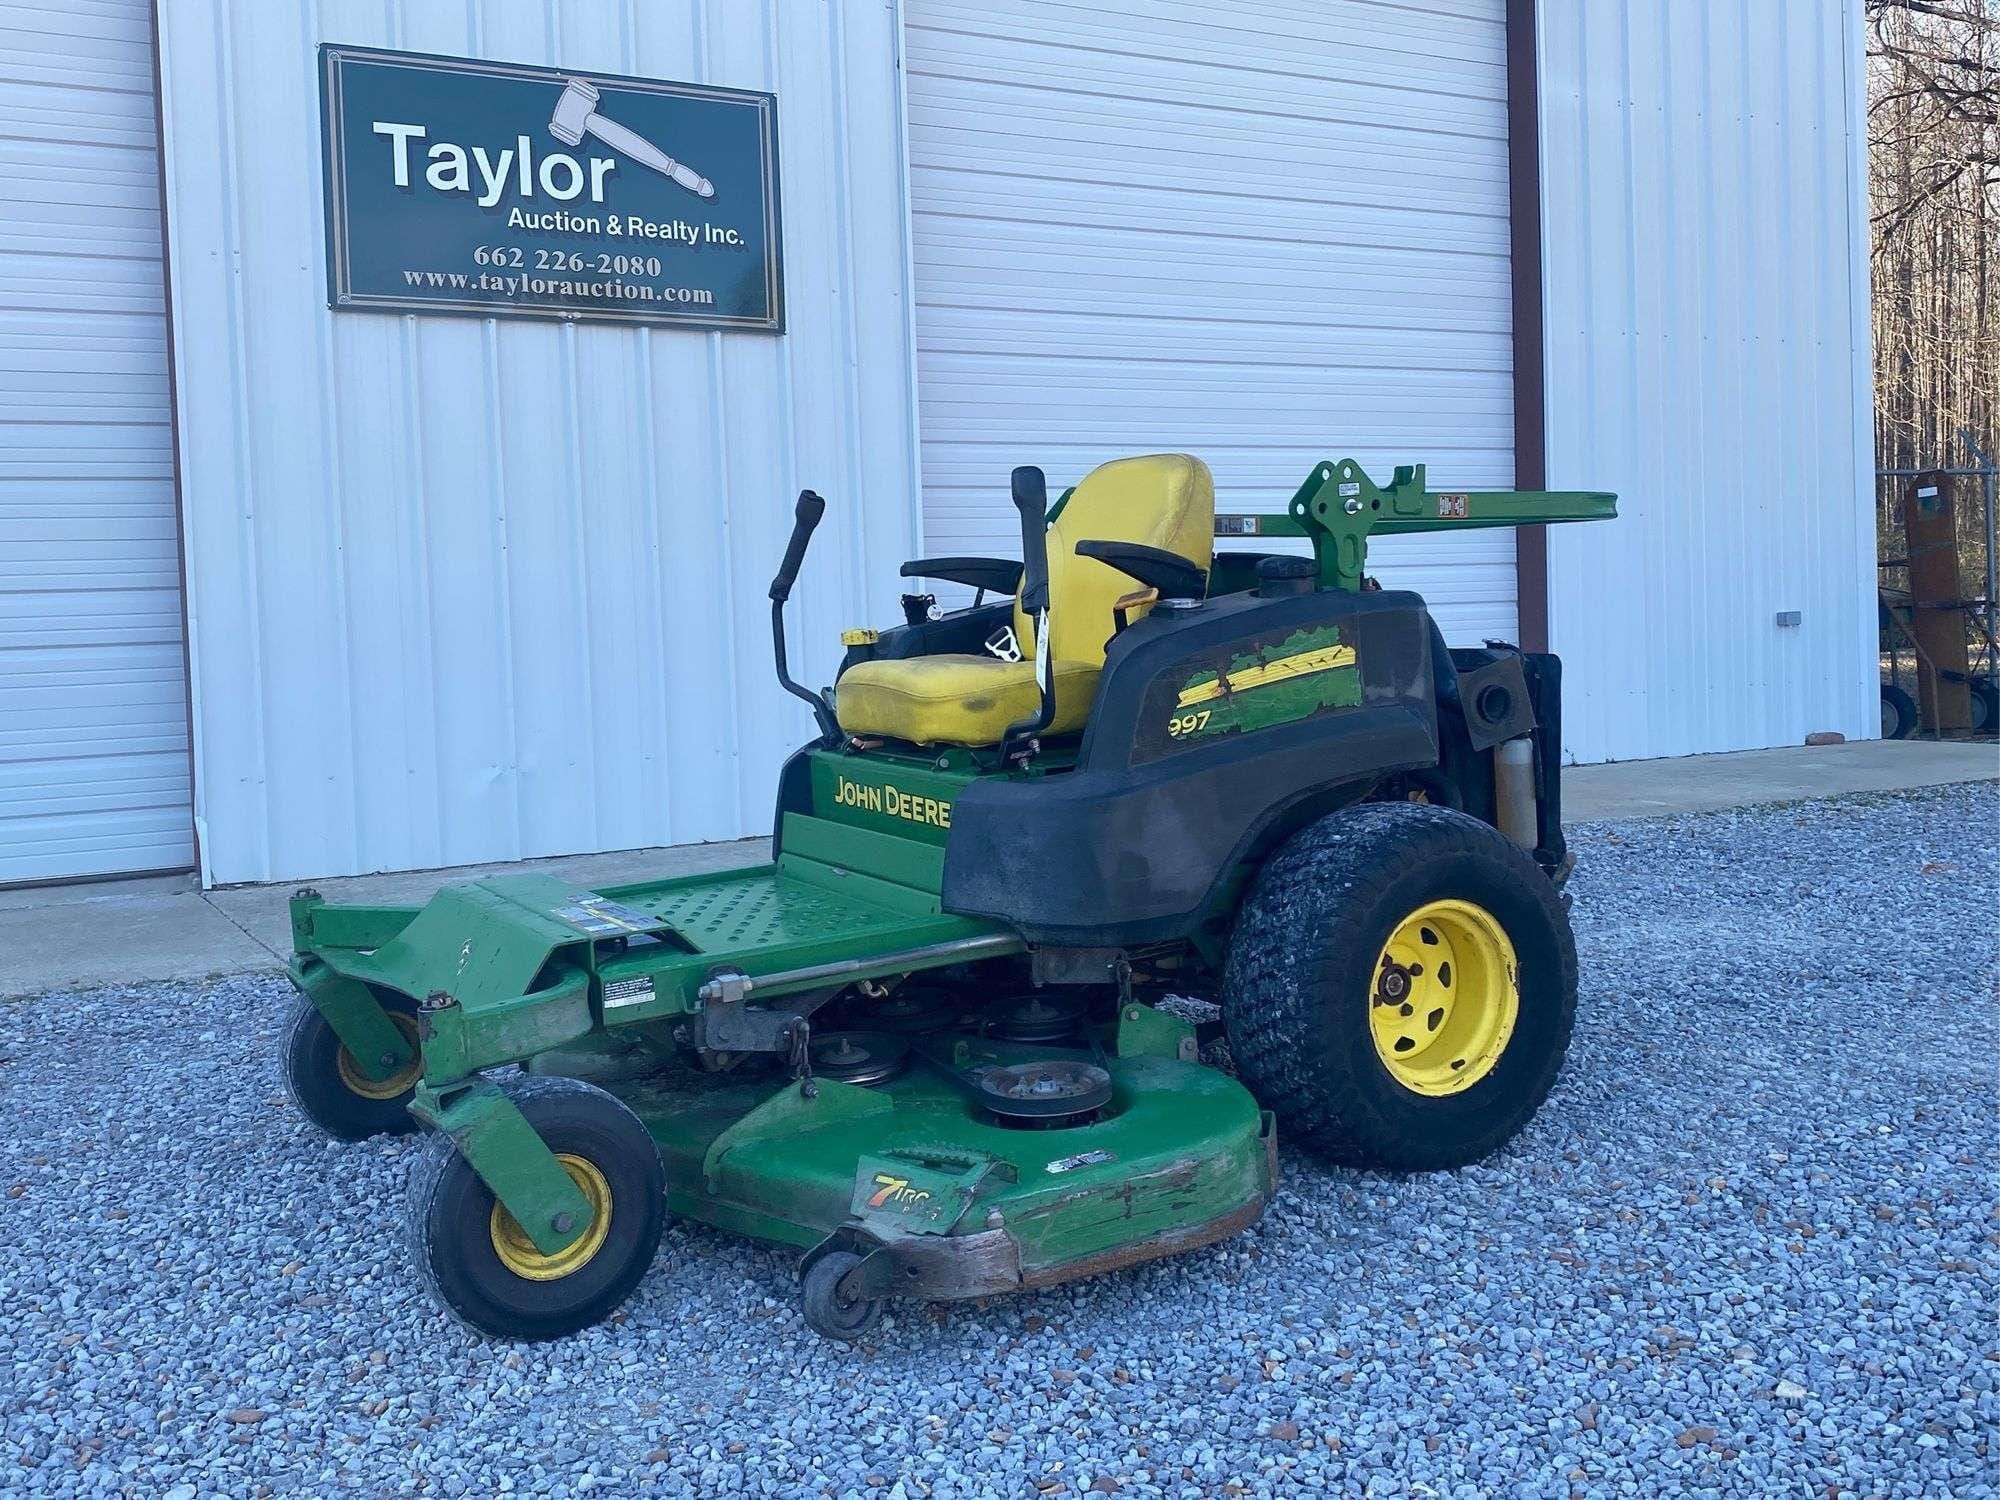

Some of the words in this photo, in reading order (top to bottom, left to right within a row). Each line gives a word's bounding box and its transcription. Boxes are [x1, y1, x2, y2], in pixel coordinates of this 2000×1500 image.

[372, 120, 615, 208] Taylor
[508, 207, 600, 235] Auction
[606, 214, 624, 236] &
[628, 216, 700, 245] Realty
[705, 223, 746, 245] Inc.
[473, 244, 525, 270] 662
[535, 248, 662, 277] 226-2080
[403, 268, 714, 304] www.taylorauction.com
[1167, 709, 1211, 737] 997
[834, 775, 882, 813] JOHN
[885, 784, 951, 829] DEERE
